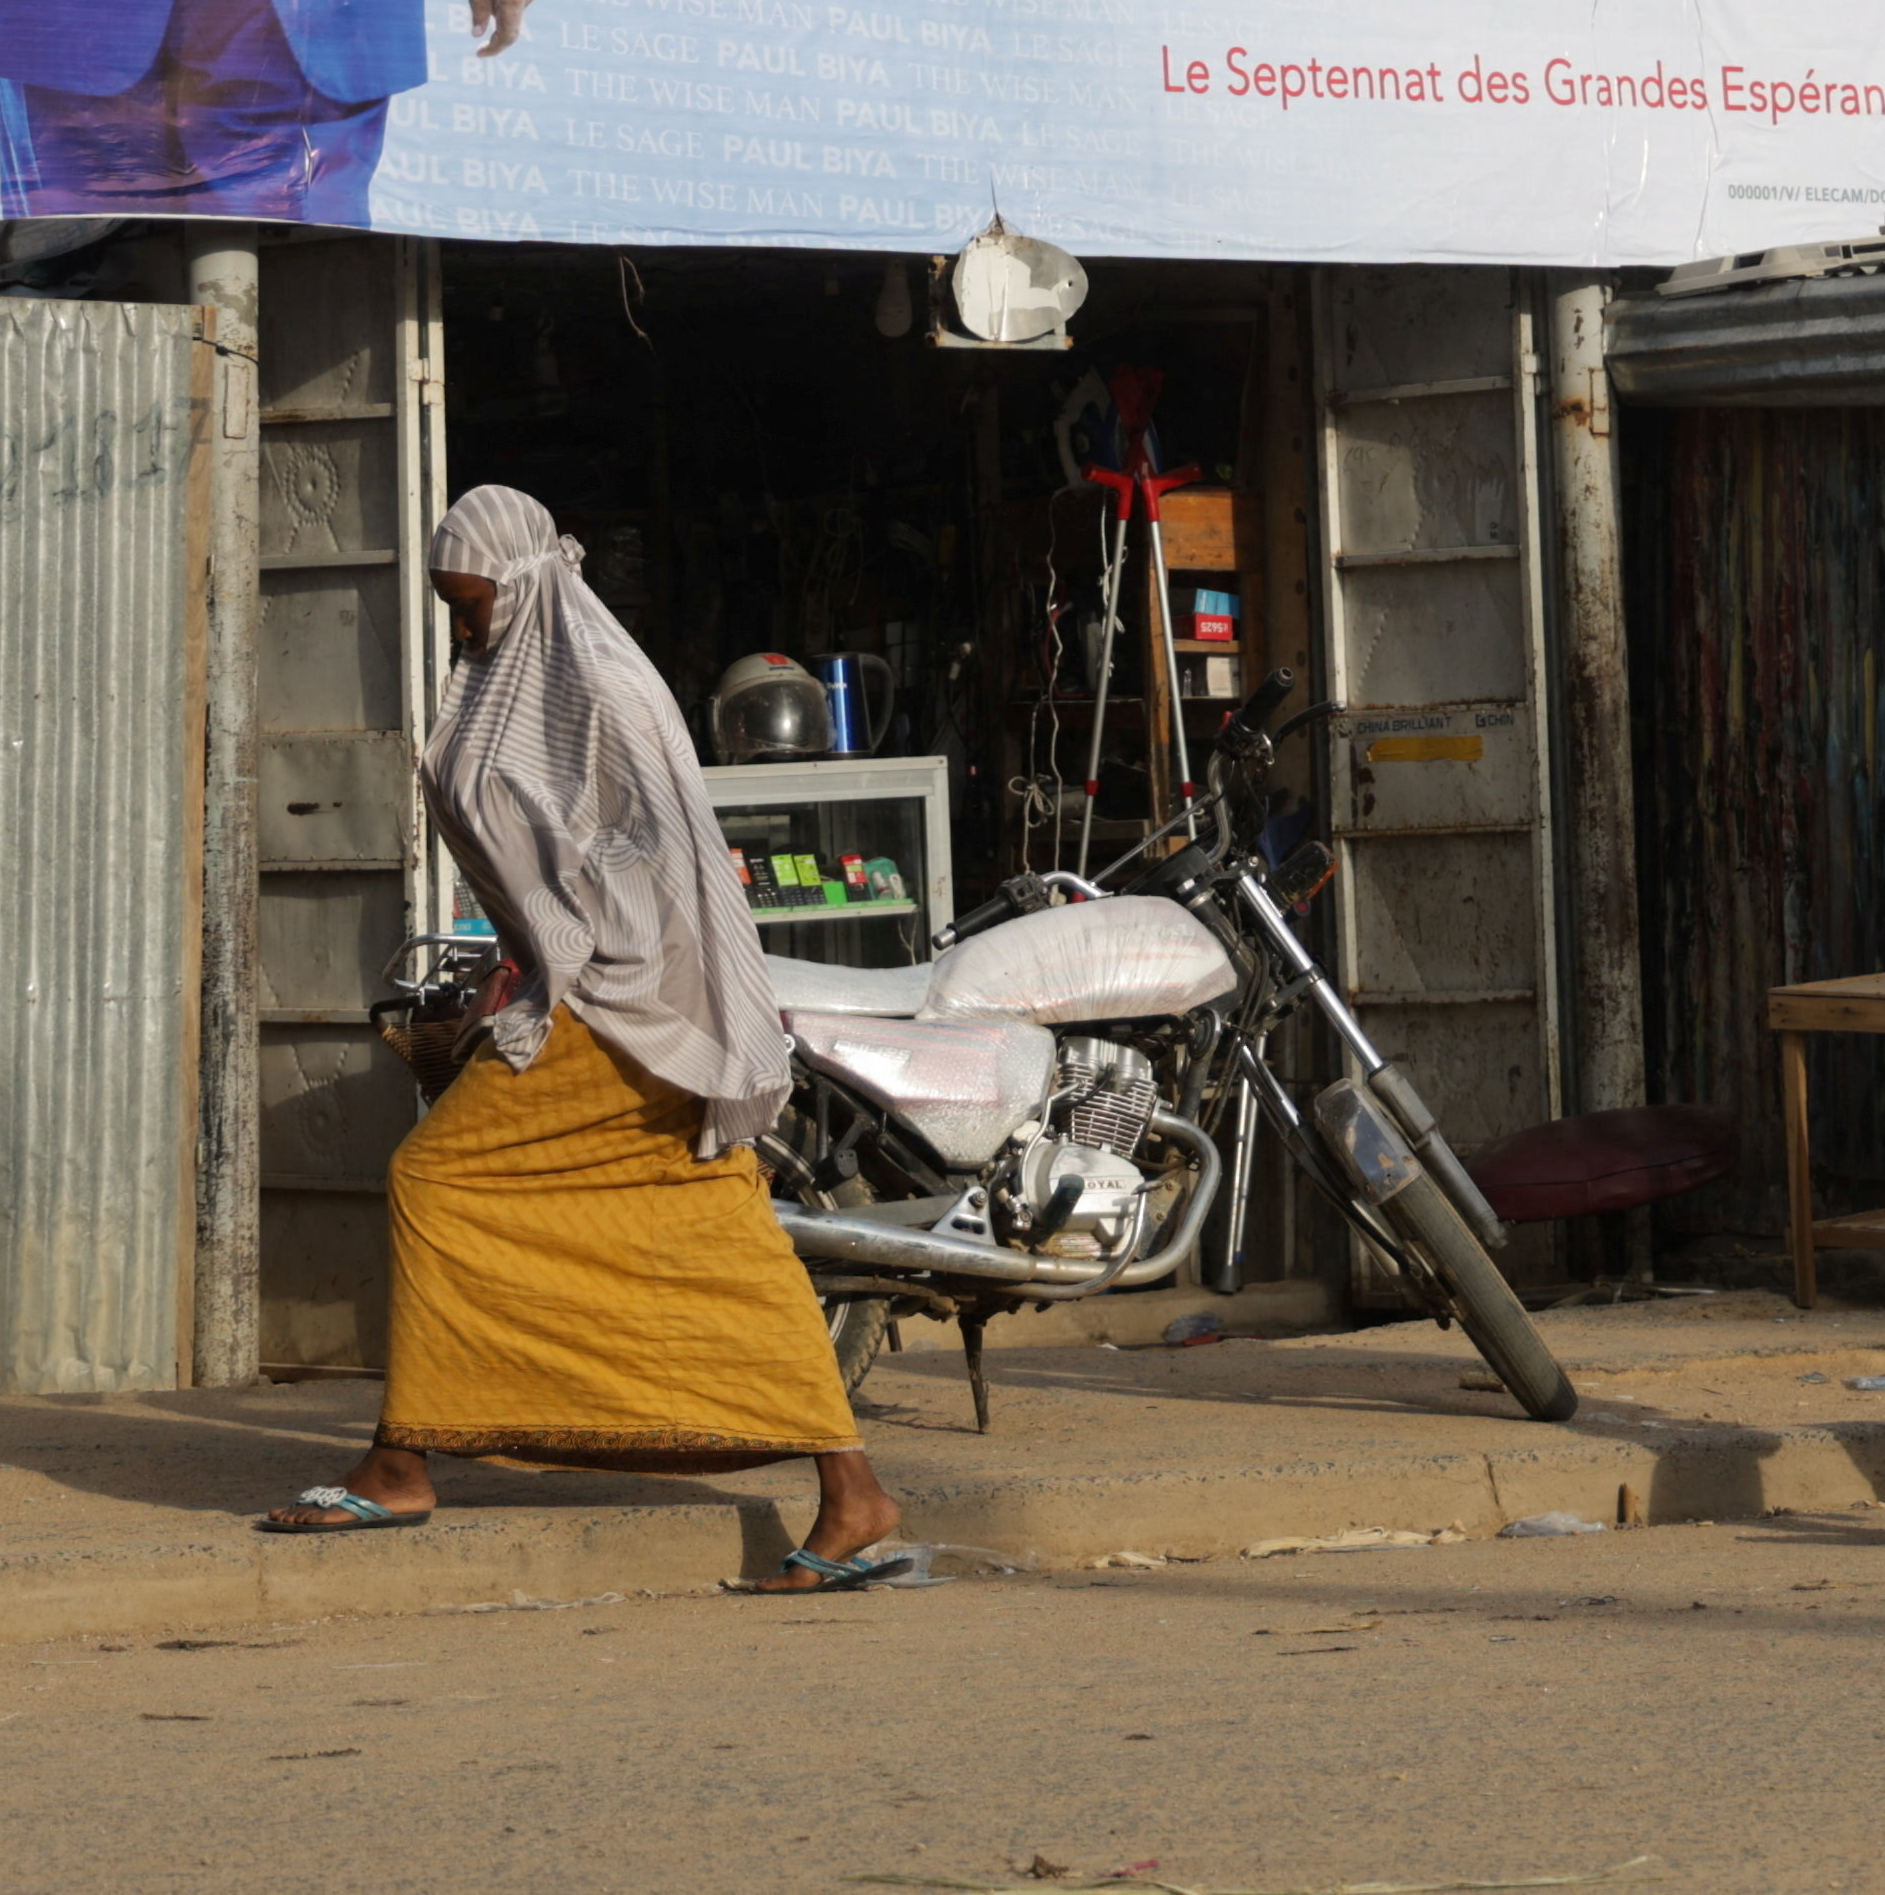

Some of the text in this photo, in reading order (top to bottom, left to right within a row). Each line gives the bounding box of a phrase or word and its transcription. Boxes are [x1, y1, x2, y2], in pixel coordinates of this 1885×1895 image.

[560, 22, 1060, 104] LE SAGE PAUL BIYA THE WISE
[1161, 45, 1210, 94] Le
[1227, 48, 1443, 109] Septennat
[1459, 54, 1530, 104] des
[1546, 58, 1707, 110] Grandes
[462, 56, 1003, 143] BIYA THE WISE MAN PAUL BIYA
[453, 103, 540, 140] BIYA
[565, 119, 607, 148] LE
[617, 124, 706, 159] SAGE
[724, 135, 812, 170] PAUL
[823, 146, 897, 179] BIYA
[916, 153, 979, 183] THE
[462, 158, 924, 228] BIYA THE WISE MAN PAUL
[1357, 720, 1390, 735] CHINA
[1392, 716, 1452, 732] BRILLIANT
[1083, 1178, 1123, 1190] OYAL
